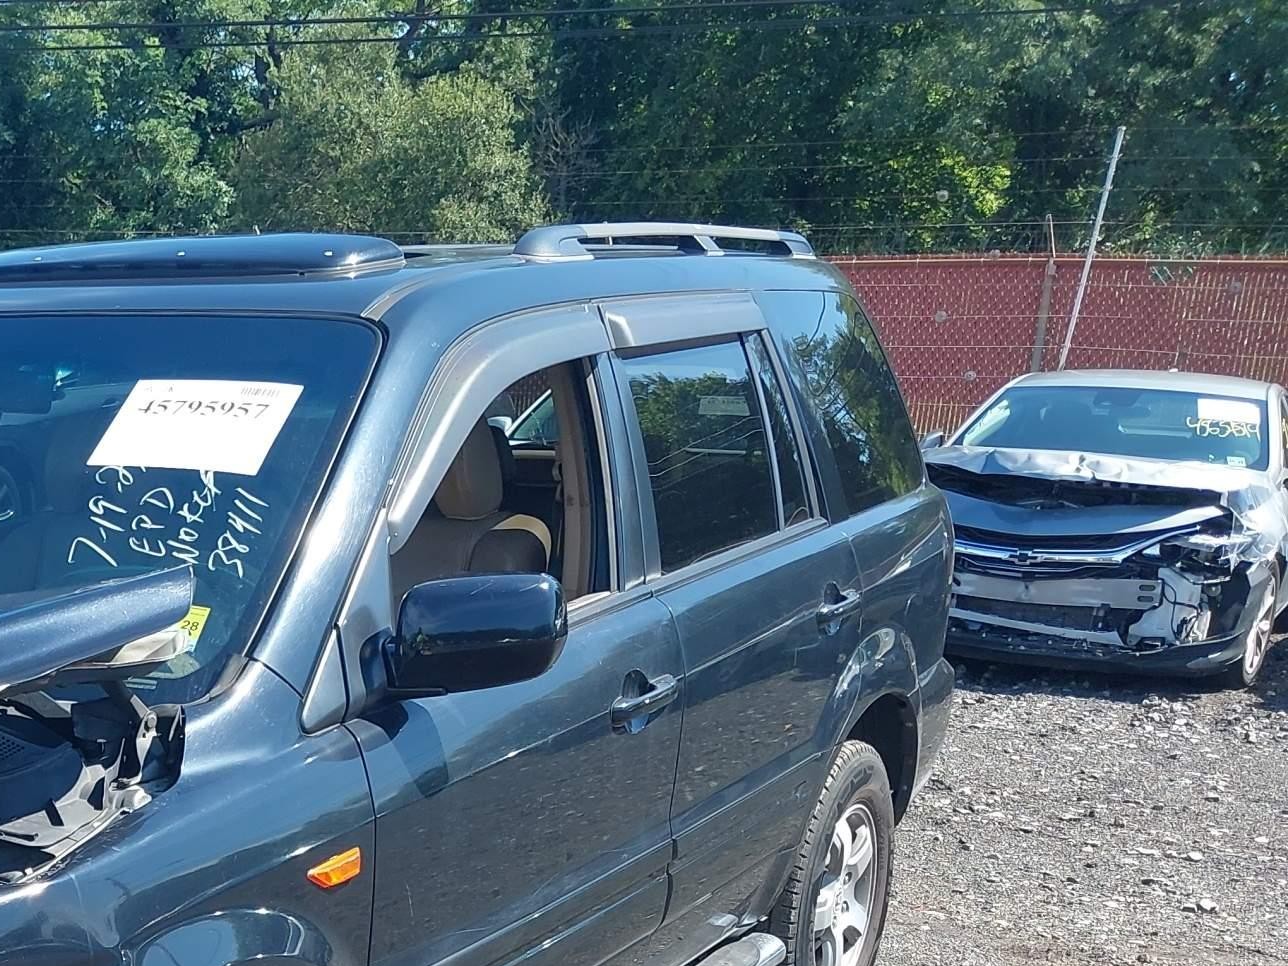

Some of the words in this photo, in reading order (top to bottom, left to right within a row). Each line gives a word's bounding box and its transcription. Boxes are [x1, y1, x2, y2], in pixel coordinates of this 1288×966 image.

[138, 400, 270, 419] 45795957
[208, 487, 270, 579] 38411
[180, 620, 199, 631] 28
